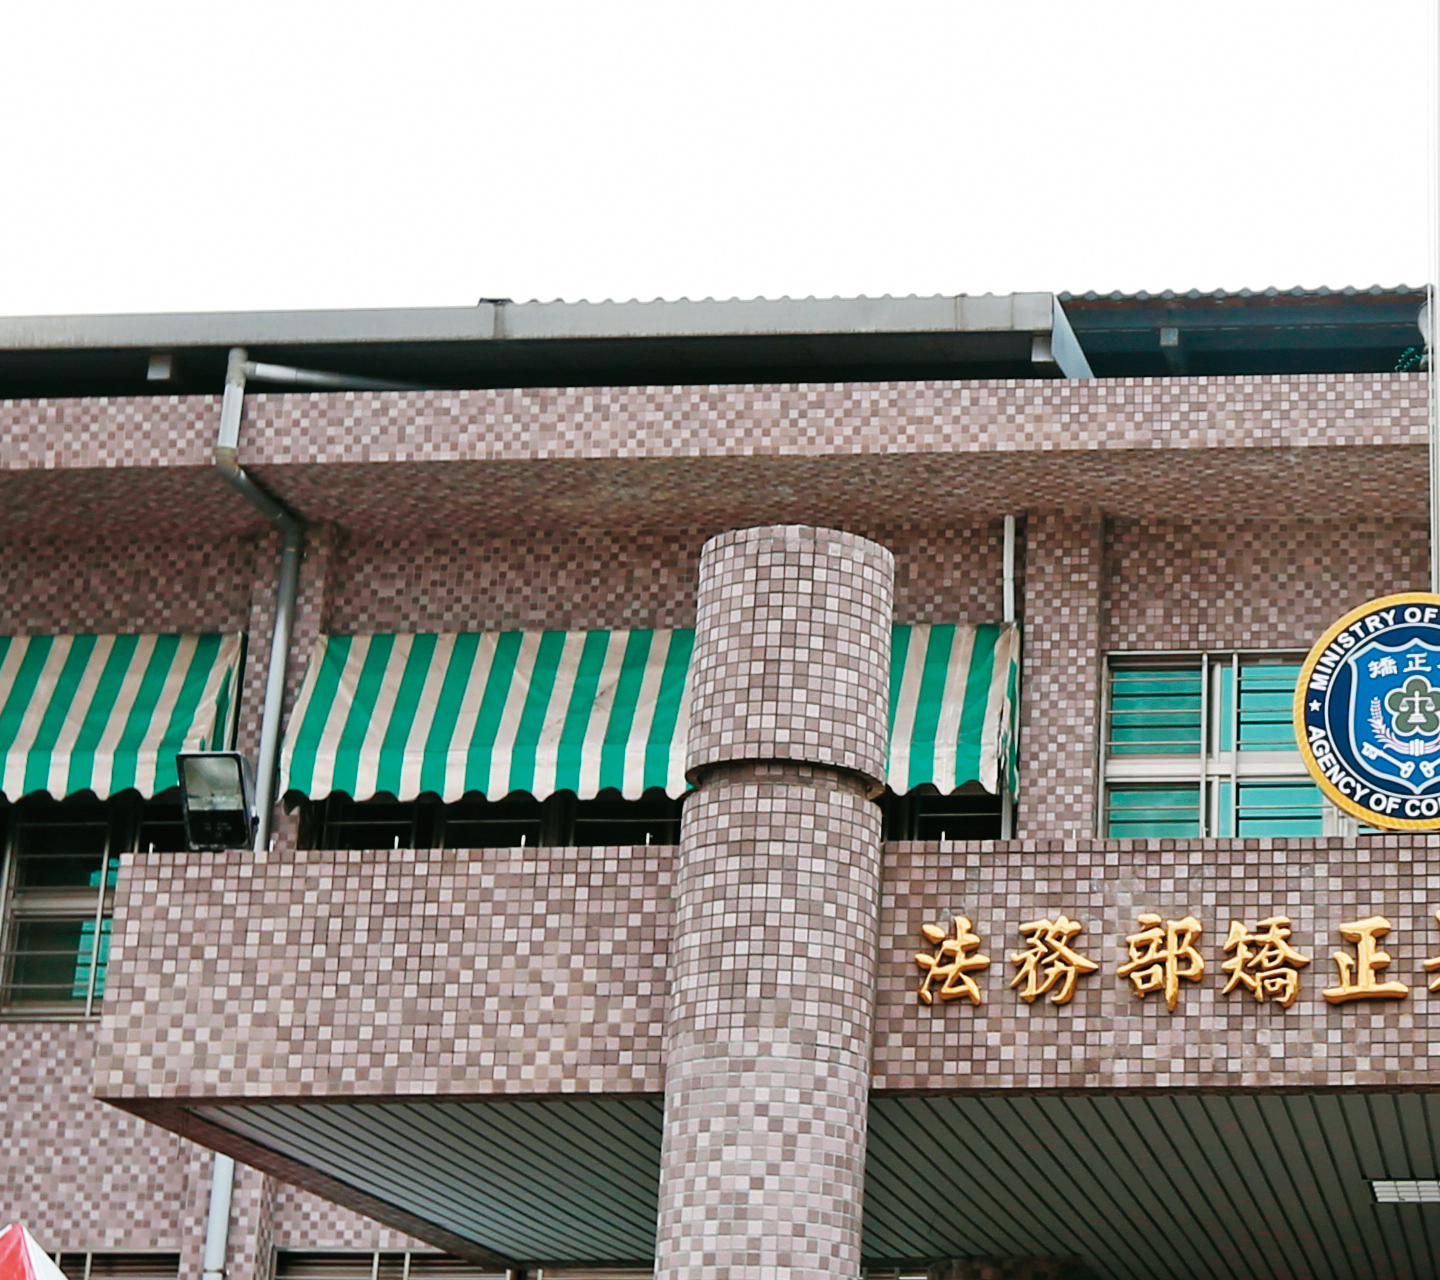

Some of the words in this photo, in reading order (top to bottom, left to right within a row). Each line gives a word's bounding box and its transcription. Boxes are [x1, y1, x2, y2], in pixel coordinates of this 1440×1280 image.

[1310, 608, 1397, 691] MINISTRY
[1404, 606, 1438, 624] OF
[1308, 724, 1371, 803] AGENCY
[1369, 795, 1402, 815] OF
